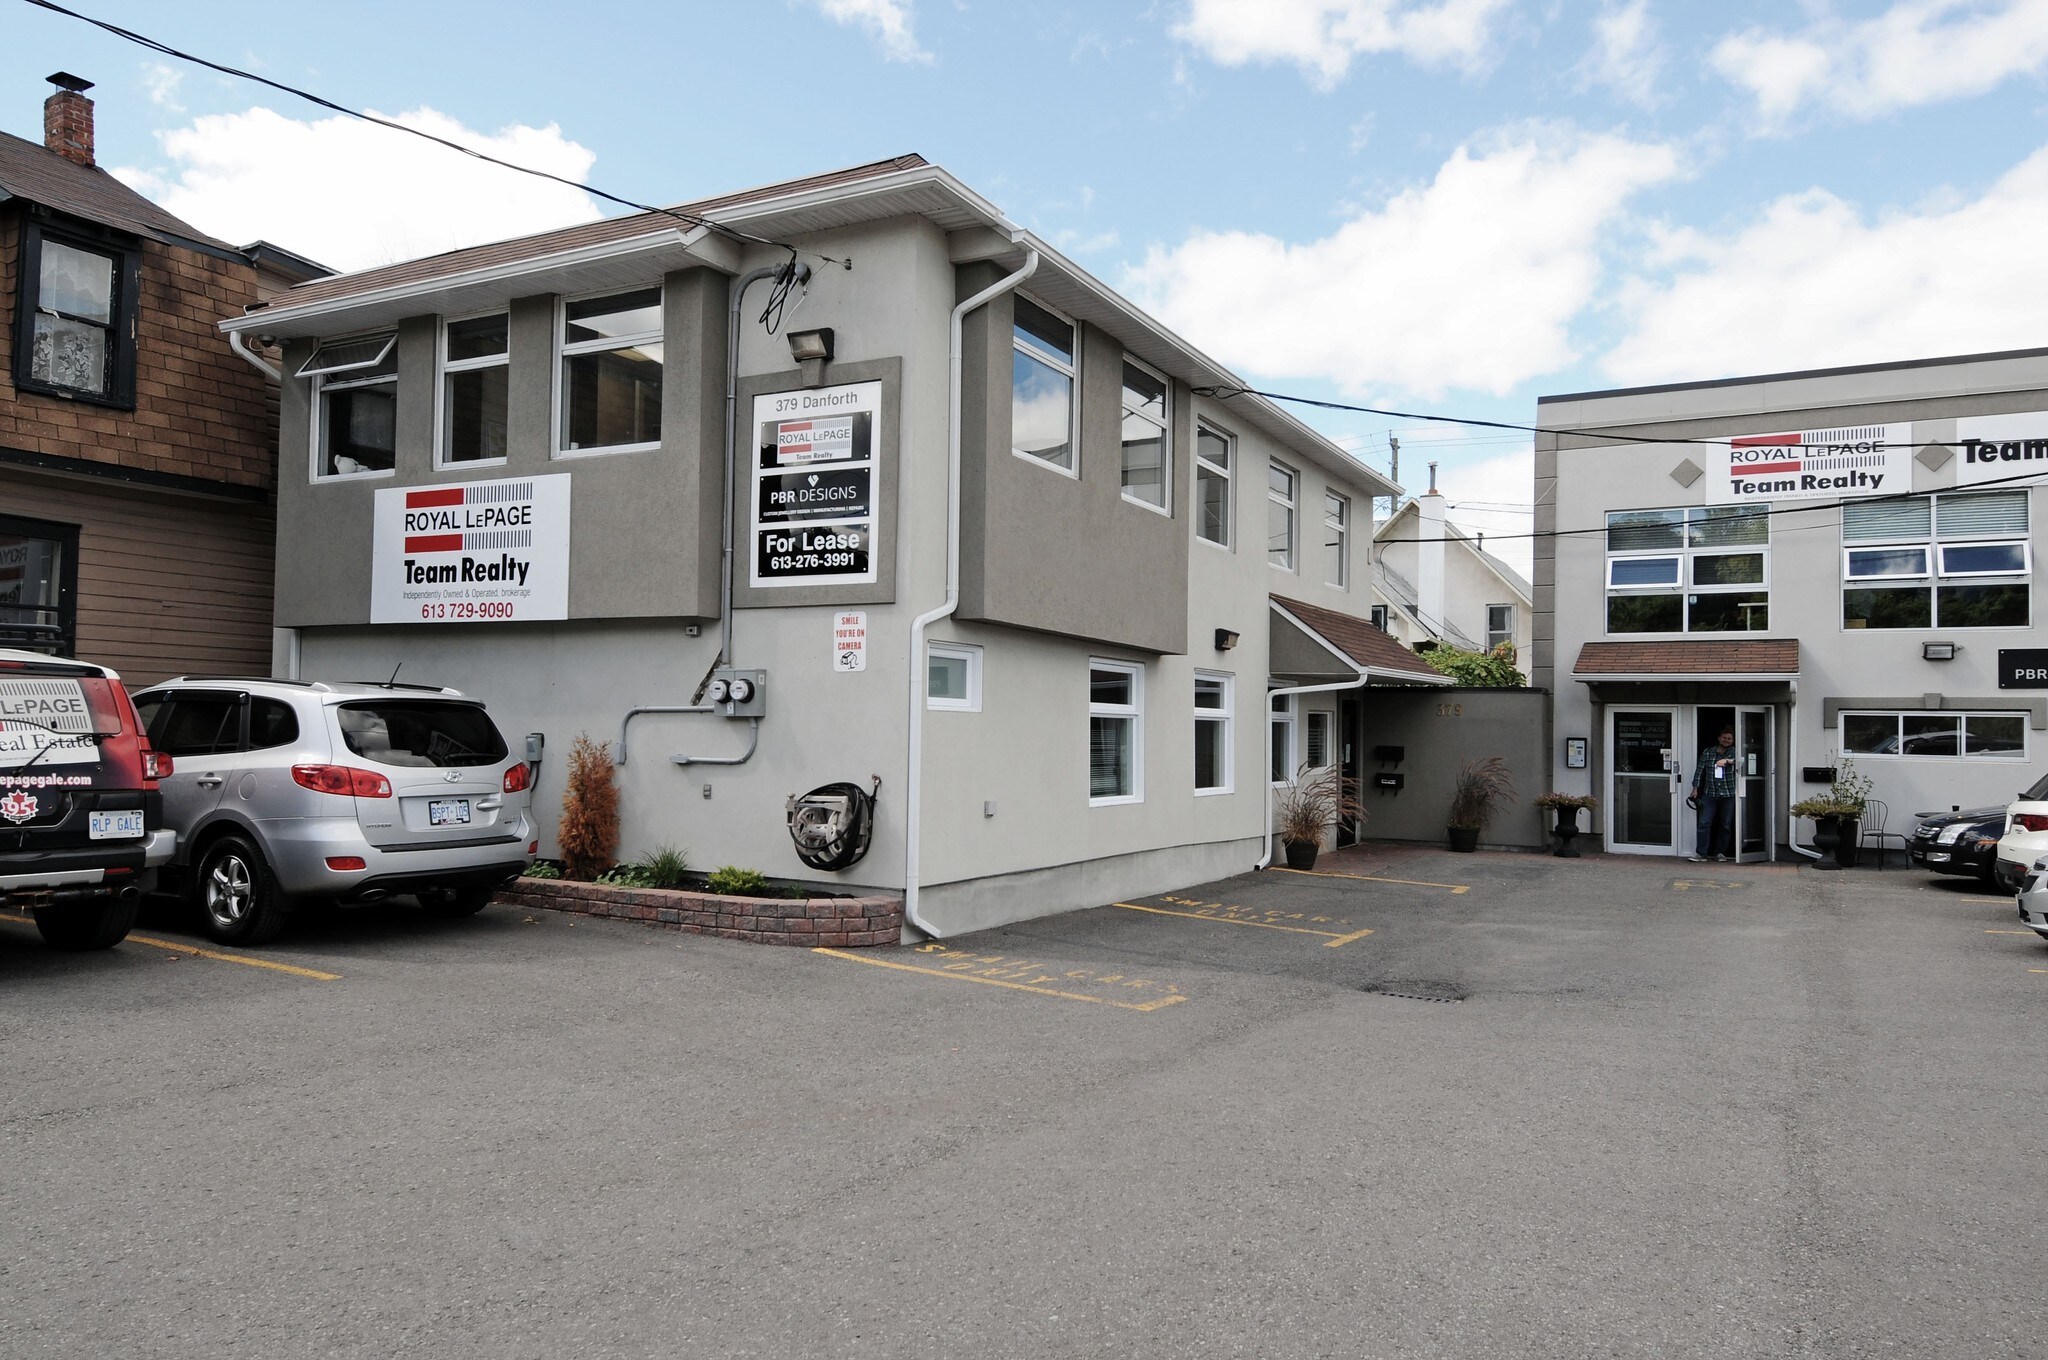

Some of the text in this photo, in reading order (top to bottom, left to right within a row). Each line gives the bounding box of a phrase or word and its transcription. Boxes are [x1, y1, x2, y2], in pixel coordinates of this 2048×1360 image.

[776, 392, 858, 412] 379 Danforth
[779, 433, 811, 444] ROYAL
[1730, 448, 1799, 463] ROYAL
[1961, 438, 2048, 463] Team
[1730, 470, 1885, 494] Team Realty
[770, 485, 857, 504] PBR DESIGNS
[404, 510, 461, 532] ROYAL
[766, 532, 860, 554] For Lease
[771, 552, 855, 570] 613-276-3991
[404, 553, 530, 586] Team Realty
[402, 591, 441, 600] Independently
[443, 589, 463, 598] Owned
[464, 589, 470, 598] &
[501, 588, 531, 598] brokerage
[421, 602, 513, 619] 613 729-9090
[841, 616, 859, 625] SMILE
[836, 629, 865, 638] YOU'RE ON
[837, 642, 862, 650] CAMERA
[2015, 668, 2047, 680] PBR
[1436, 703, 1464, 717] 379
[30, 734, 93, 750] Estate
[1641, 739, 1667, 747] Realty
[7, 802, 31, 816] 95
[92, 816, 141, 832] RLP GALE
